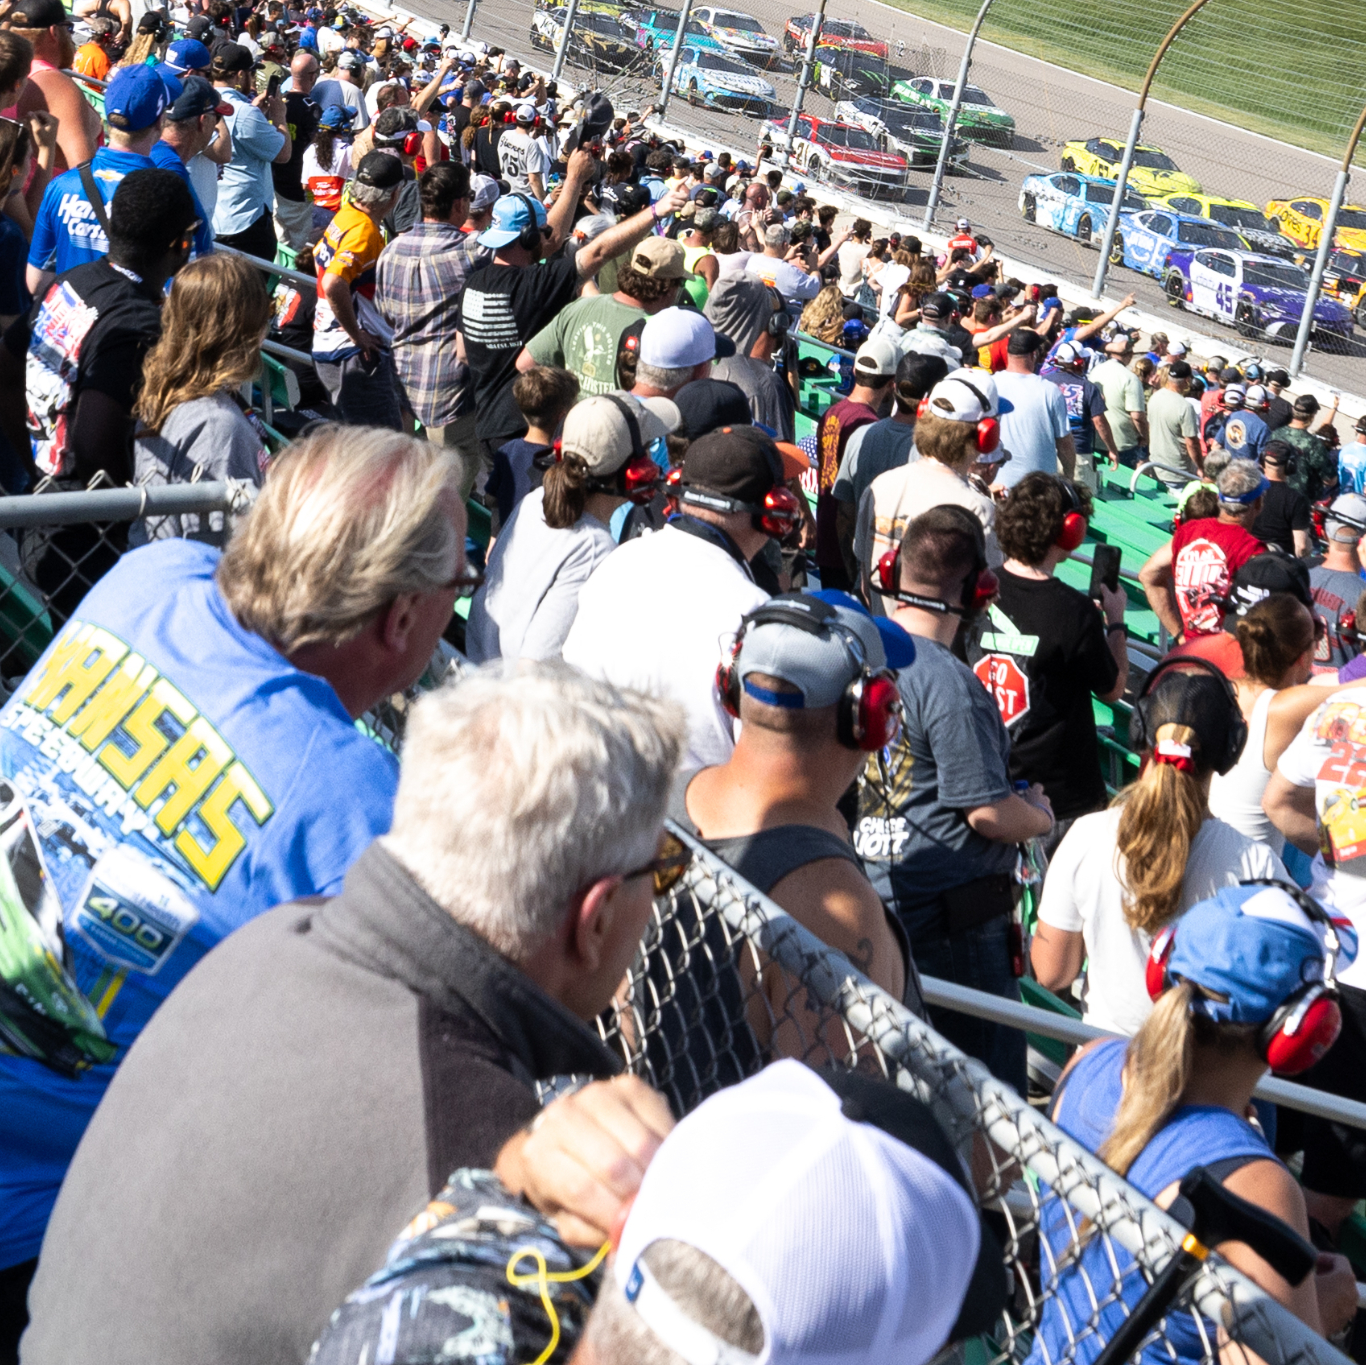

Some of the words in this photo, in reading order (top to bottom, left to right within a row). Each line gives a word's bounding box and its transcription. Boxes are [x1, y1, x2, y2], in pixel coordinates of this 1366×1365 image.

[1215, 281, 1234, 315] 45
[985, 684, 1018, 716] AST
[1, 704, 150, 836] SPEEDWAY
[21, 622, 276, 894] KANSAS
[88, 895, 164, 951] 400
